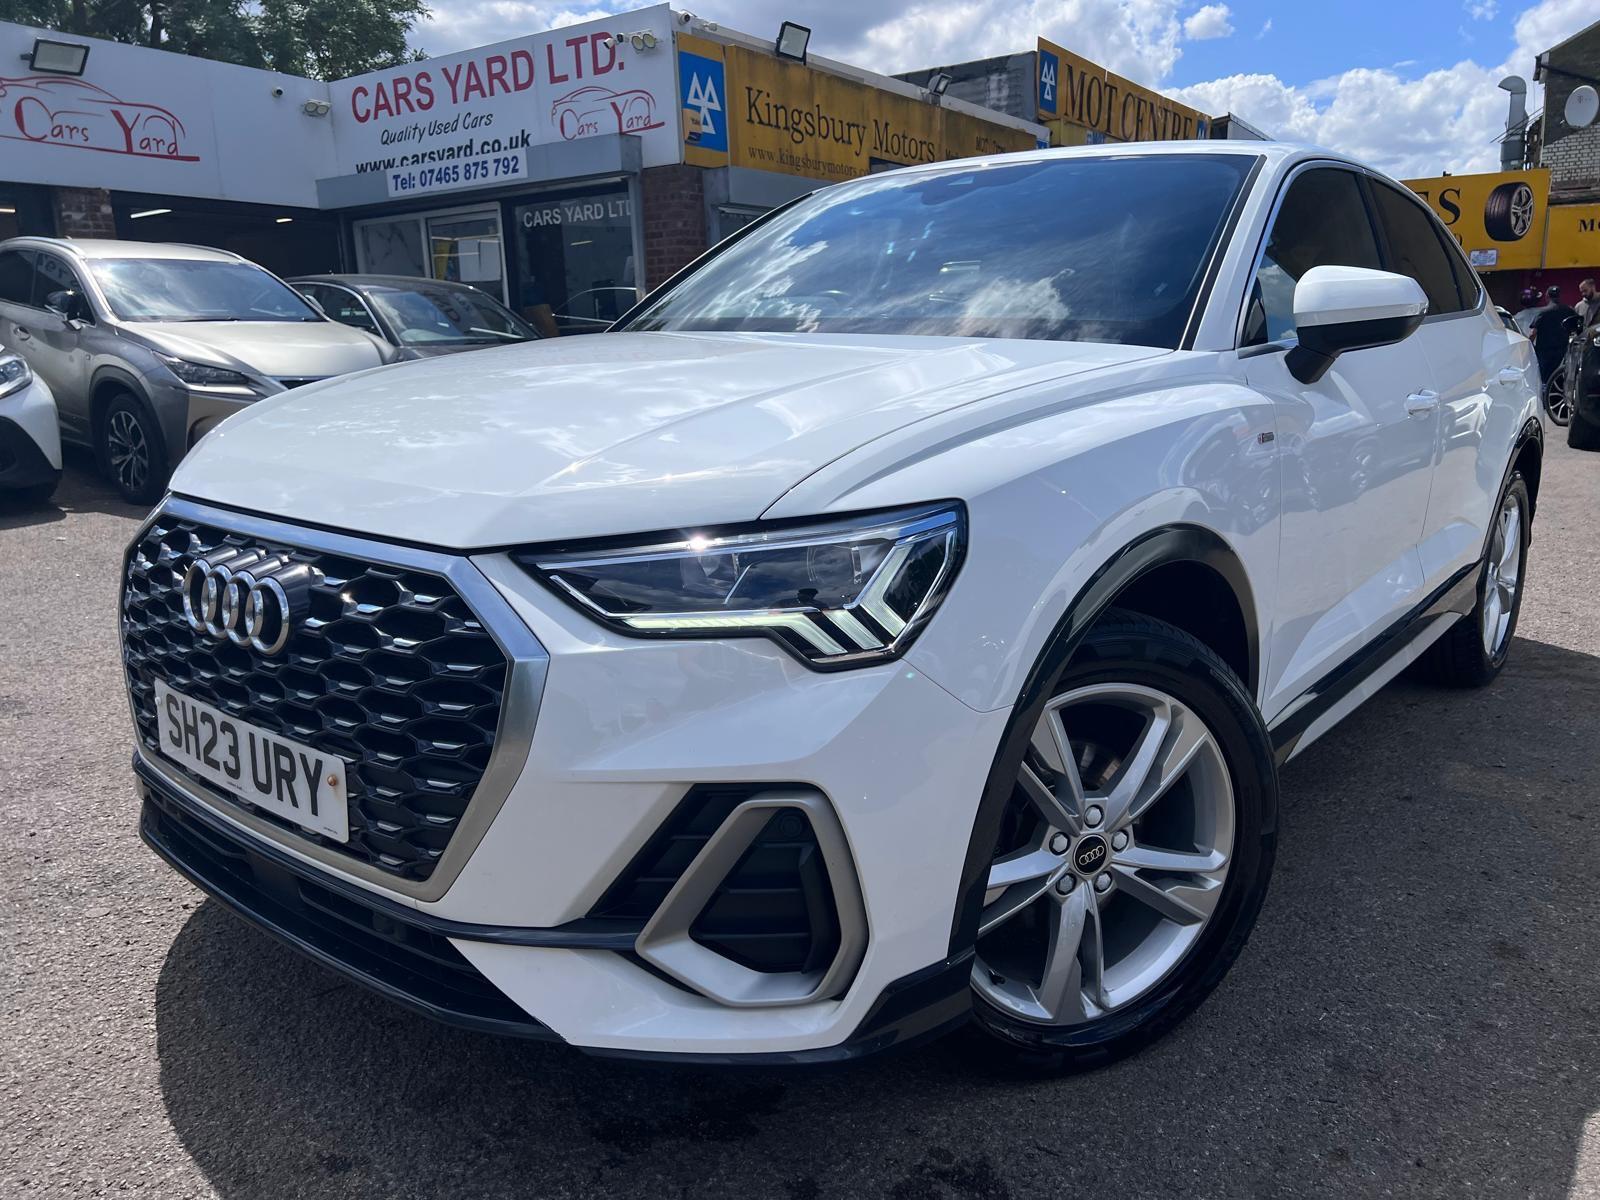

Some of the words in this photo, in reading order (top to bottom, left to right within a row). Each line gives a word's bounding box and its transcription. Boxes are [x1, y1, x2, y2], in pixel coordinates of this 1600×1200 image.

[351, 71, 435, 123] CARS
[441, 50, 535, 104] YARD
[546, 32, 625, 84] LTD.
[560, 108, 599, 140] Cars
[610, 97, 652, 134] Yard
[1064, 64, 1118, 134] MOT
[1122, 92, 1193, 141] CENTRE
[15, 96, 89, 141] Cars
[110, 109, 179, 156] Yard
[380, 125, 426, 146] Quality
[428, 113, 459, 136] Used
[462, 111, 494, 130] Cars
[745, 86, 866, 157] Kingsbury
[873, 119, 936, 163] Motors
[392, 172, 416, 191] Tel:
[419, 162, 459, 188] 07465
[464, 160, 489, 181] 875
[493, 155, 520, 177] 792
[523, 208, 562, 228] CARS
[564, 203, 604, 223] YARD
[1415, 188, 1461, 225] S
[1578, 217, 1600, 233] M
[166, 693, 241, 780] SH23
[249, 731, 323, 817] URY
